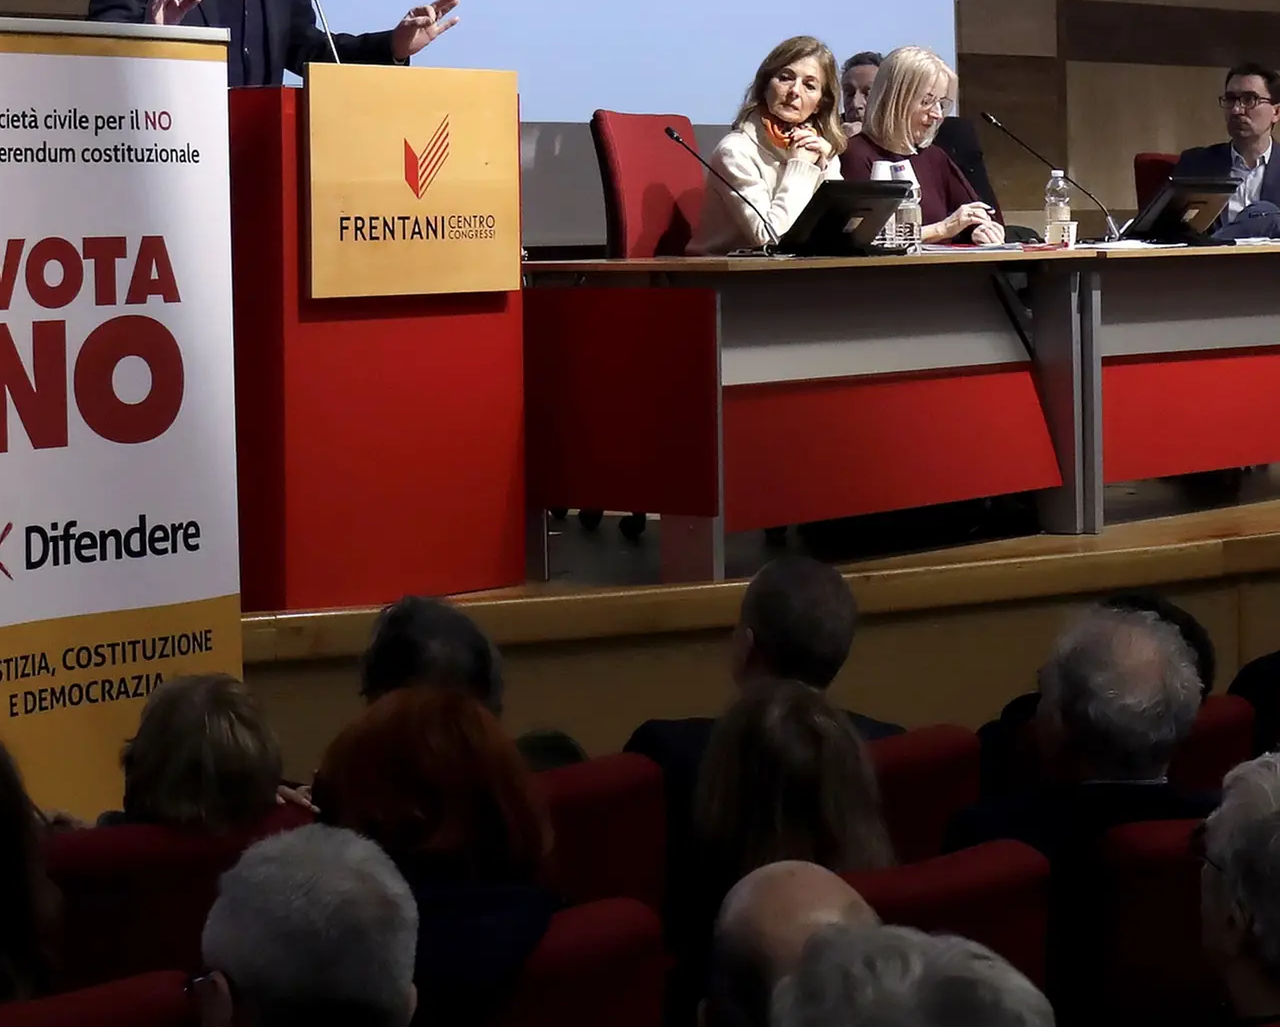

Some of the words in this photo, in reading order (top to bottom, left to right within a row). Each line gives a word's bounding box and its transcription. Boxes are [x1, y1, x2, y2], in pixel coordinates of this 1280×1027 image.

[44, 108, 89, 130] civile
[94, 114, 125, 136] per
[130, 109, 140, 130] il
[145, 111, 173, 130] NO
[81, 143, 200, 163] costituzionale
[339, 216, 445, 241] FRENTANI
[448, 215, 496, 229] CENTRO
[448, 229, 495, 240] CONGRESSI
[25, 514, 201, 570] Difendere
[62, 629, 213, 671] COSTITUZIONE
[10, 693, 19, 717] E
